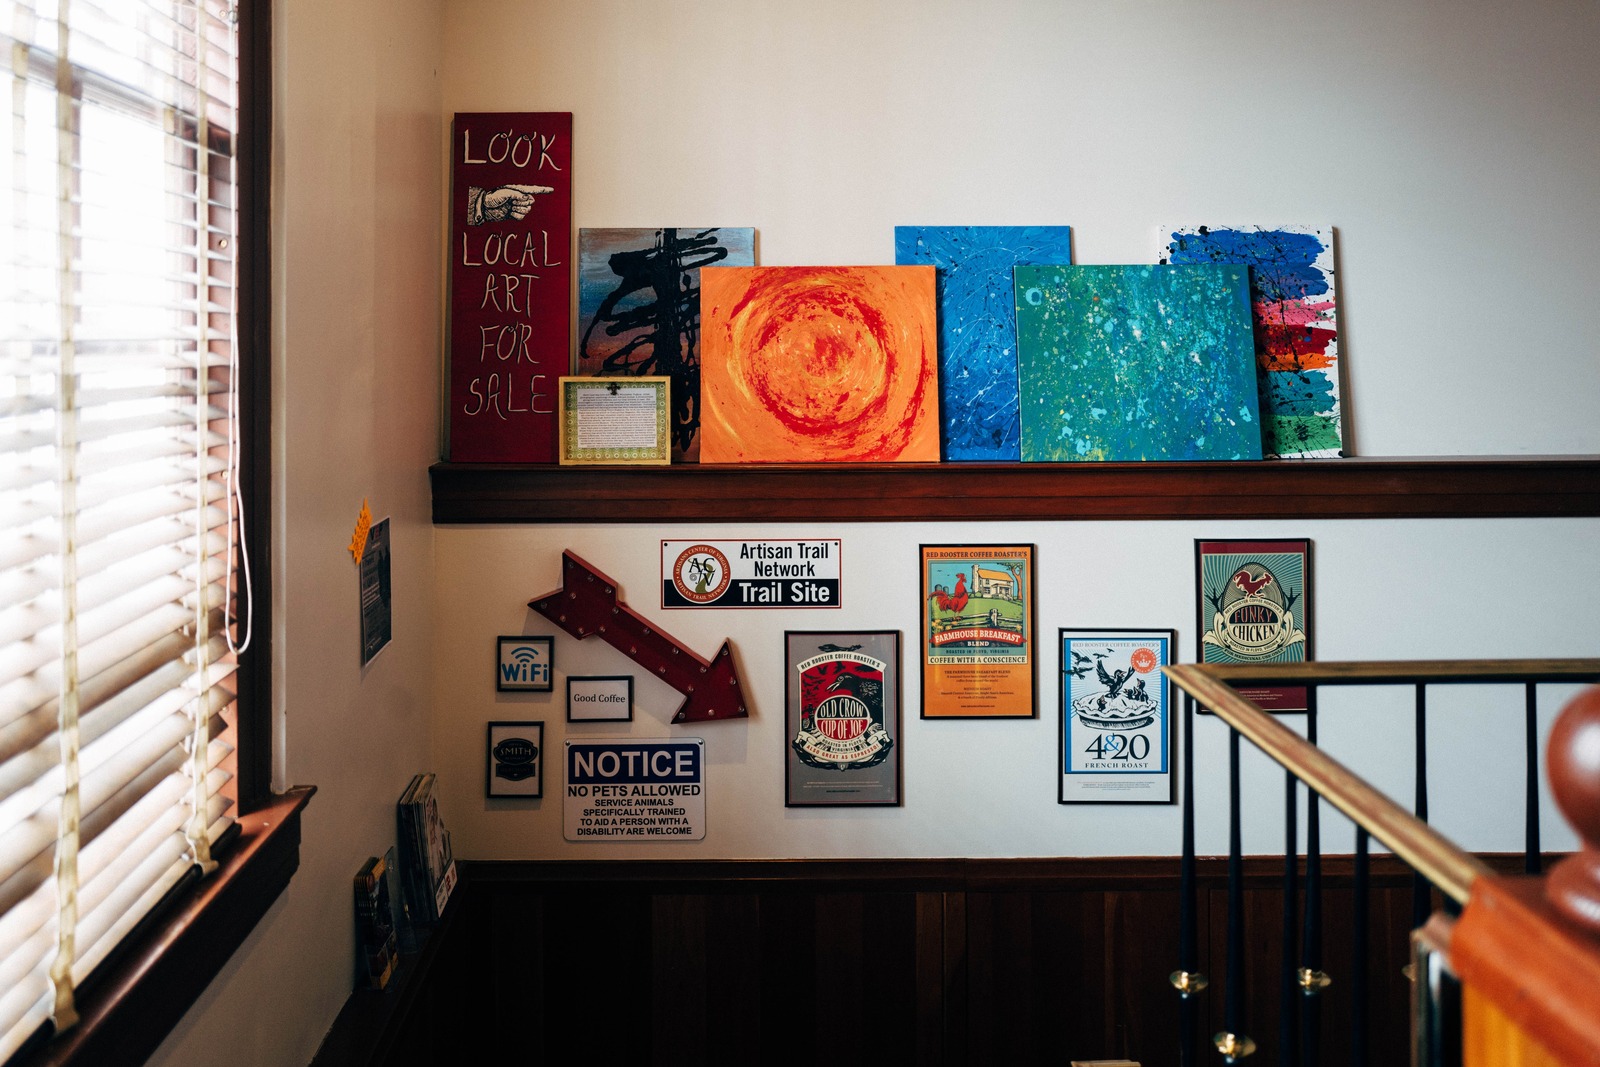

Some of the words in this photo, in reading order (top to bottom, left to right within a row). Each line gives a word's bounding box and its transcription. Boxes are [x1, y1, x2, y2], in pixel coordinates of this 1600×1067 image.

[463, 128, 562, 171] LOOK
[462, 229, 561, 267] LOCAL
[480, 273, 541, 318] ART
[479, 321, 540, 364] FOR
[464, 373, 553, 420] SALE
[688, 546, 708, 556] CENTER
[716, 552, 728, 574] VIRGINIA
[740, 543, 793, 560] Artisan
[797, 543, 829, 560] Trail
[754, 560, 815, 577] Network
[676, 579, 692, 597] ARTISAN
[708, 580, 728, 599] NETWORK
[739, 582, 782, 602] Trail
[791, 582, 830, 603] Site
[1234, 606, 1273, 623] FUNKY
[934, 629, 979, 644] FARMHOUSE
[979, 629, 1021, 643] BREAKFAST
[1232, 624, 1275, 642] CHICKEN
[800, 662, 811, 670] RED
[811, 654, 834, 666] ROOSTER
[1234, 653, 1261, 661] MEDICINAL
[501, 663, 548, 682] WiFi
[573, 693, 596, 703] Good
[598, 693, 626, 703] Coffee
[820, 698, 837, 718] OLD
[839, 697, 865, 718] CROW
[820, 719, 837, 739] CUP
[837, 719, 848, 740] OF
[848, 719, 864, 740] JOE
[806, 744, 820, 755] ALSO
[821, 751, 839, 760] GREAT
[850, 743, 880, 759] ESPRESSO!
[821, 738, 841, 748] ROASTED
[500, 747, 532, 757] SMITH
[574, 750, 694, 778] NOTICE
[568, 786, 588, 797] NO
[592, 785, 628, 797] PETS
[631, 785, 700, 797] ALLOWED
[594, 799, 632, 807] SERVICE
[635, 798, 674, 806] ANIMALS
[583, 808, 645, 816] SPECIFICALLY
[647, 808, 686, 816] TRAINED
[580, 818, 592, 826] TO
[594, 818, 609, 826] AID
[611, 818, 618, 826] A
[620, 818, 656, 826] PERSON
[658, 818, 680, 826] WITH
[577, 828, 625, 836] DISABILITY
[646, 827, 692, 835] WELCOME
